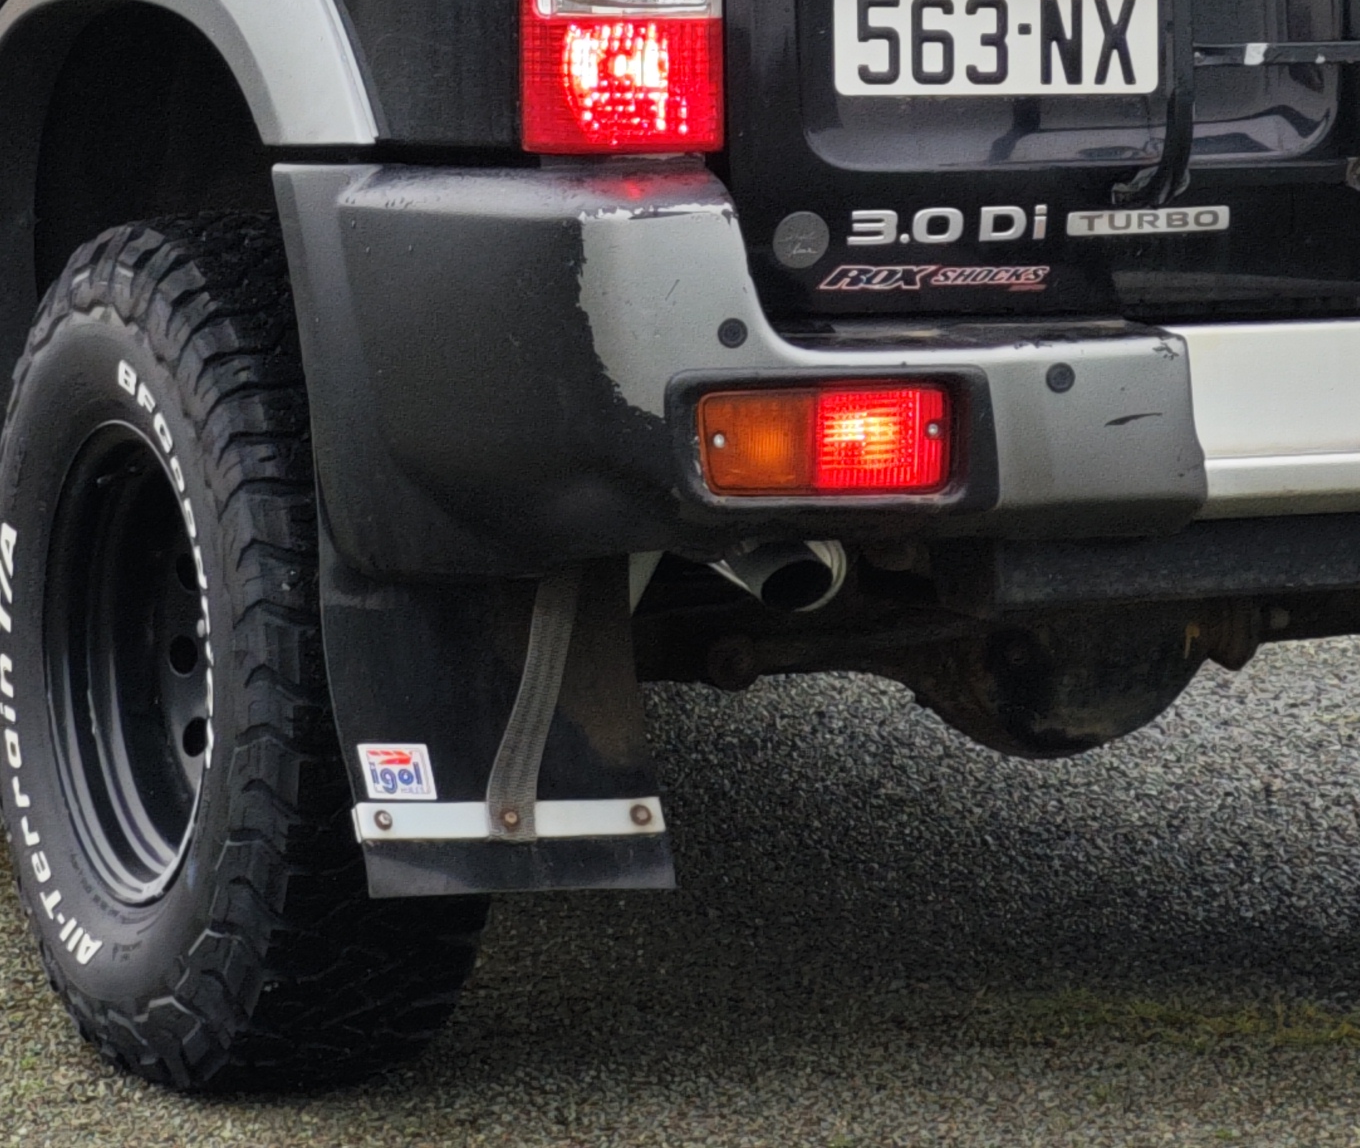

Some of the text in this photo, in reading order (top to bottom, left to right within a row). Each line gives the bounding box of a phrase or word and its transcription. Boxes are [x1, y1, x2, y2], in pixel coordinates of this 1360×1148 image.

[846, 204, 1221, 246] 3.0 Di TURBO
[930, 265, 1050, 285] SHOCKS
[369, 762, 422, 794] igol
